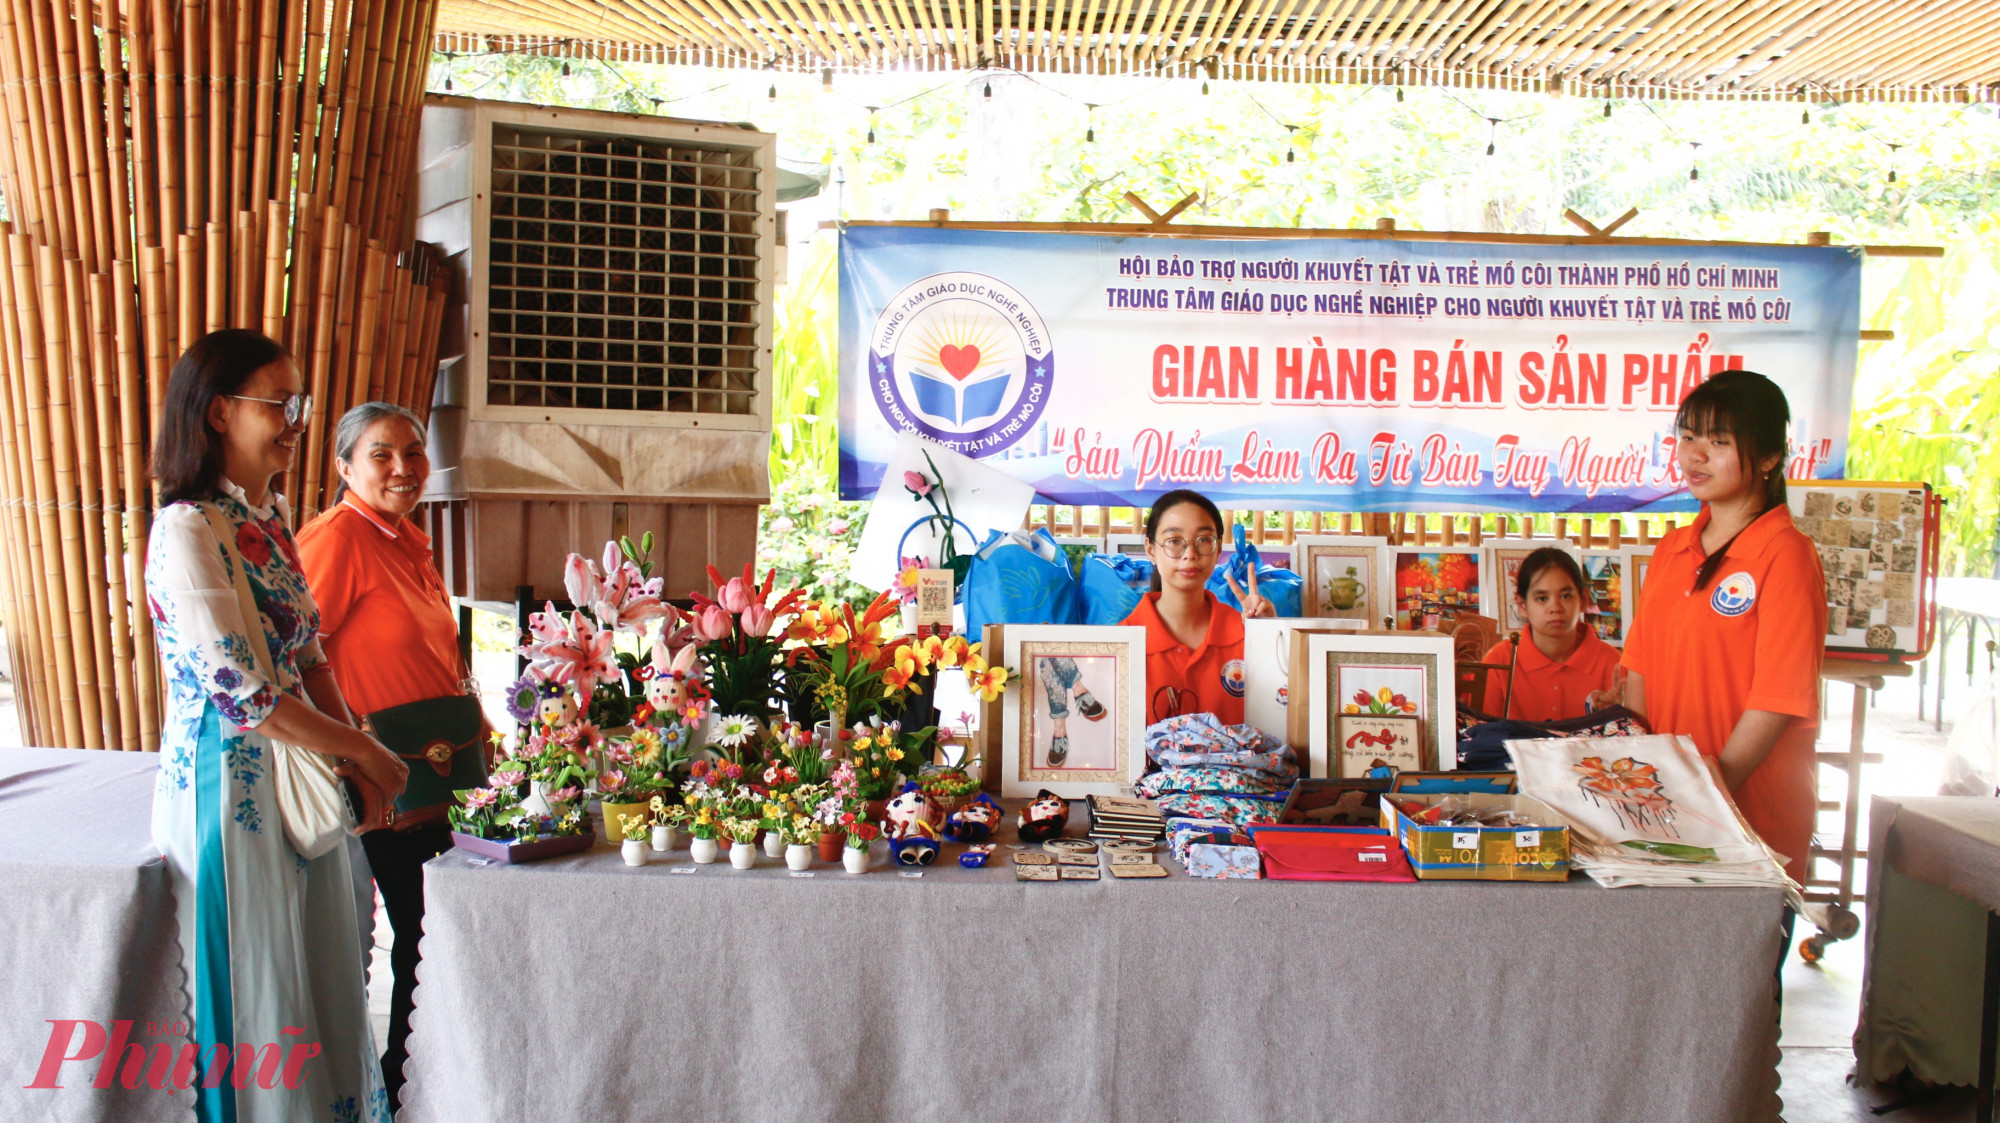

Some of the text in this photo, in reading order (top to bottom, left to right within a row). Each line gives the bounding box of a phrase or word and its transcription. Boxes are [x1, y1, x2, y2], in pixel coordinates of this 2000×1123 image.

[1106, 286, 1791, 323] TRUNG TÂM GIÁO DỤC NGHỀ NGHIỆP CHO NGƯỜI KHUYẾT TẬT VÀ TRẺ MỒ CÔI
[1119, 254, 1779, 288] HỘI BẢO TRỢ NGƯỜI KHUYẾT TẬT VÀ TRẺ MỒ CÔI THÀNH PHỐ HỒ CHÍ MINH
[880, 283, 1042, 355] TRUNG TÂM GIÁO DỤC NGHỀ NGHIỆP
[1152, 344, 1259, 398] GIAN
[1276, 336, 1396, 402] HÀNG
[1414, 339, 1503, 402] BÁN
[1519, 334, 1607, 404] SẢN
[879, 379, 895, 403] CHO
[888, 401, 918, 435] NGƯỜI
[963, 439, 984, 453] TẬT
[984, 432, 1003, 447] VÀ
[1000, 417, 1023, 437] TRẺ
[1020, 403, 1035, 422] MỒ
[1028, 382, 1044, 403] CÔI
[1133, 427, 1224, 488] Phẩm
[1232, 430, 1302, 479] Làm
[1313, 431, 1357, 481] Ra
[1369, 431, 1413, 483] Từ
[1421, 433, 1482, 484] Bàn
[1494, 433, 1549, 496] Tay
[1559, 435, 1648, 497] Người
[1460, 849, 1481, 864] 70
